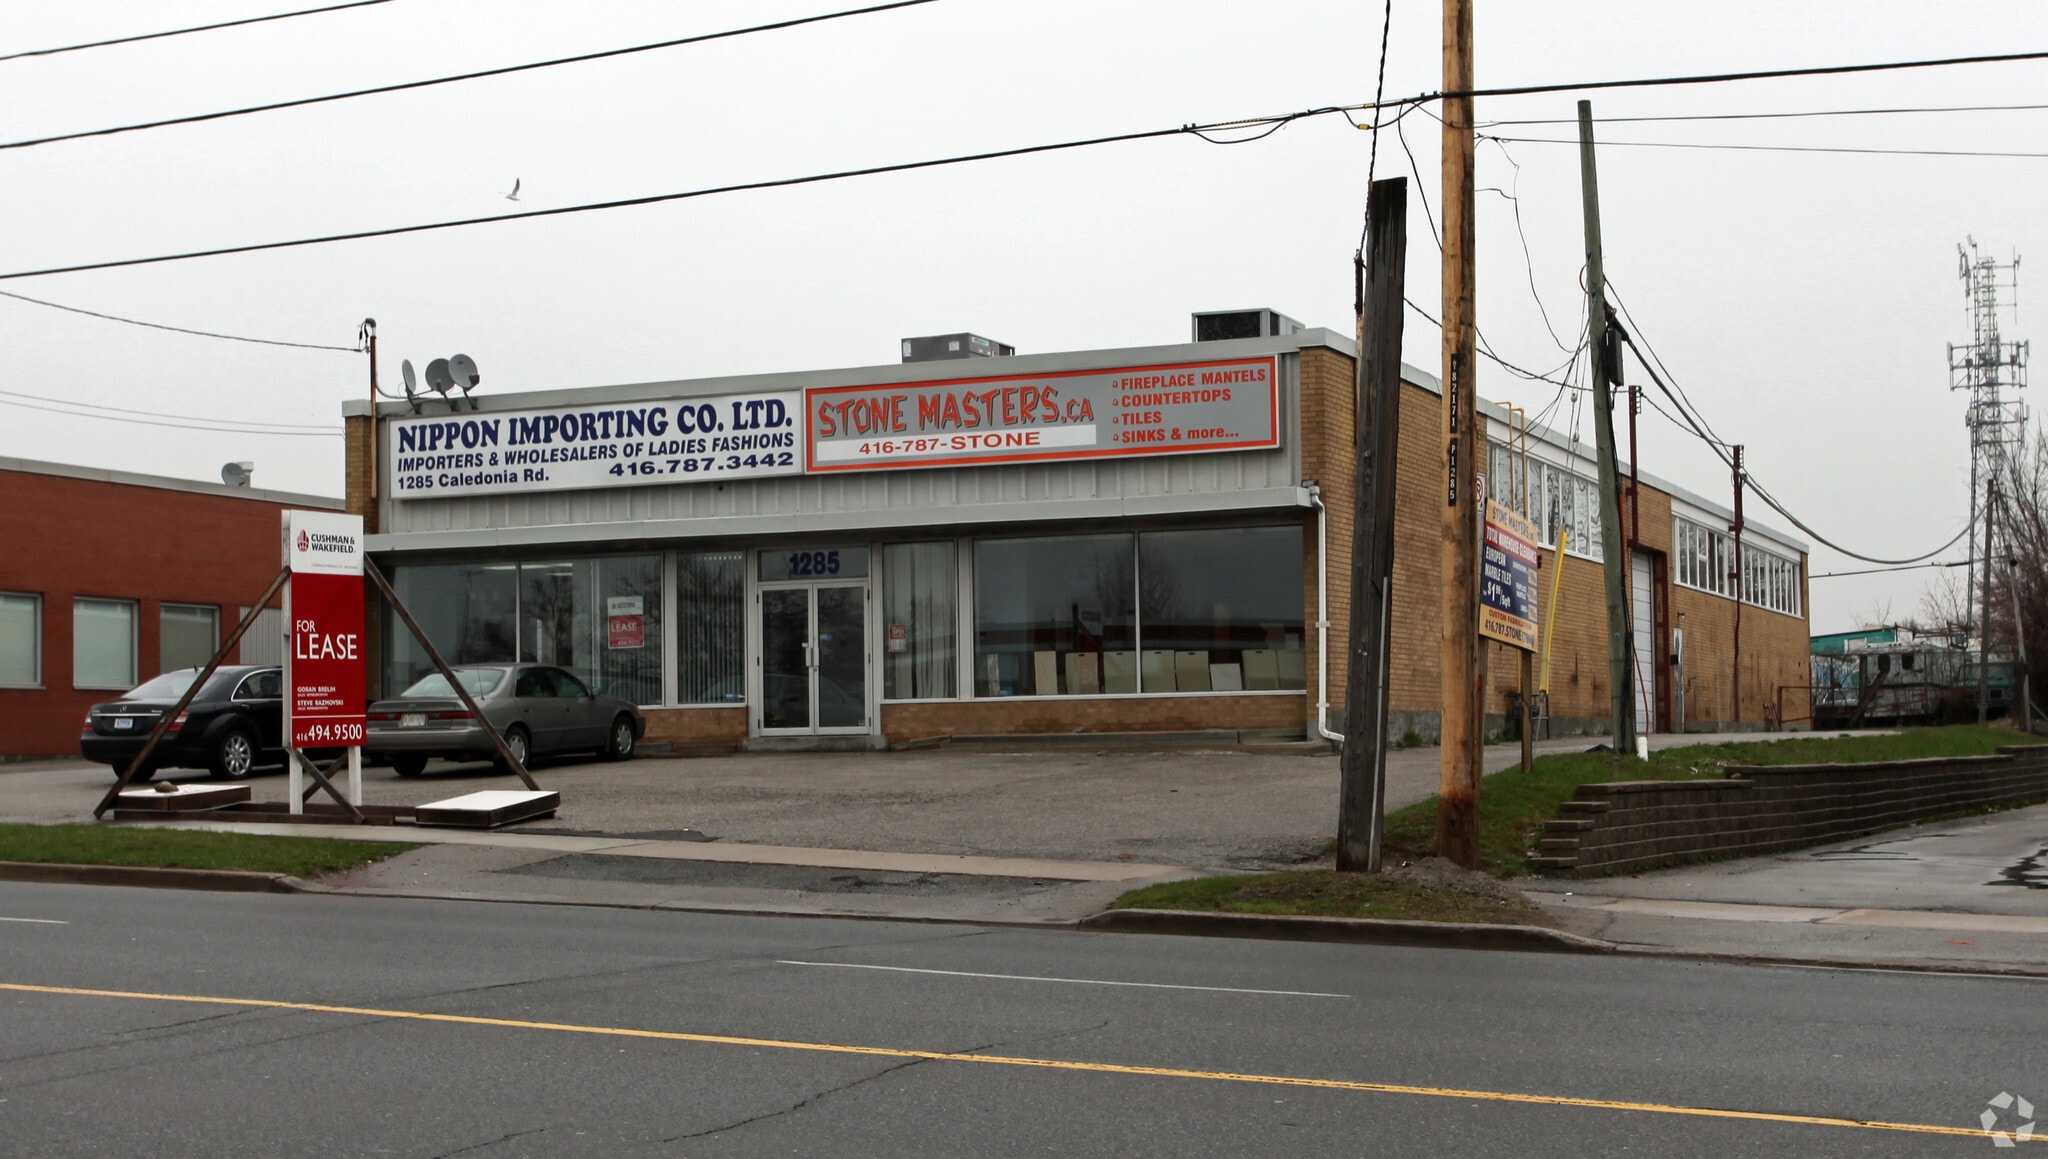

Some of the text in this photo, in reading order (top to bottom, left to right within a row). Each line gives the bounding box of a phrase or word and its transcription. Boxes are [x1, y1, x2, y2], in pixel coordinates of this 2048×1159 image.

[1121, 368, 1266, 391] FIREPLACE MANTELS
[1121, 389, 1232, 407] COUNTERTOPS
[398, 398, 793, 453] NIPPON IMPORTING CO. LTD.
[818, 393, 908, 438] STONE
[1121, 411, 1163, 426] TILES
[859, 431, 1041, 456] 416-787-STONE
[1121, 426, 1239, 444] SINKS & more...
[397, 432, 794, 472] IMPORTERS & WHOLESALERS OF LADIES FASHIONS
[609, 451, 794, 477] 416.787.3442
[398, 466, 550, 490] 1285 Caledonia Rd.
[311, 534, 349, 544] CUSHMAN
[790, 551, 840, 575] 1285
[297, 620, 315, 633] FOR
[611, 622, 637, 632] LEASE
[297, 634, 358, 660] LEASE
[296, 724, 363, 741] 416 494.9500
